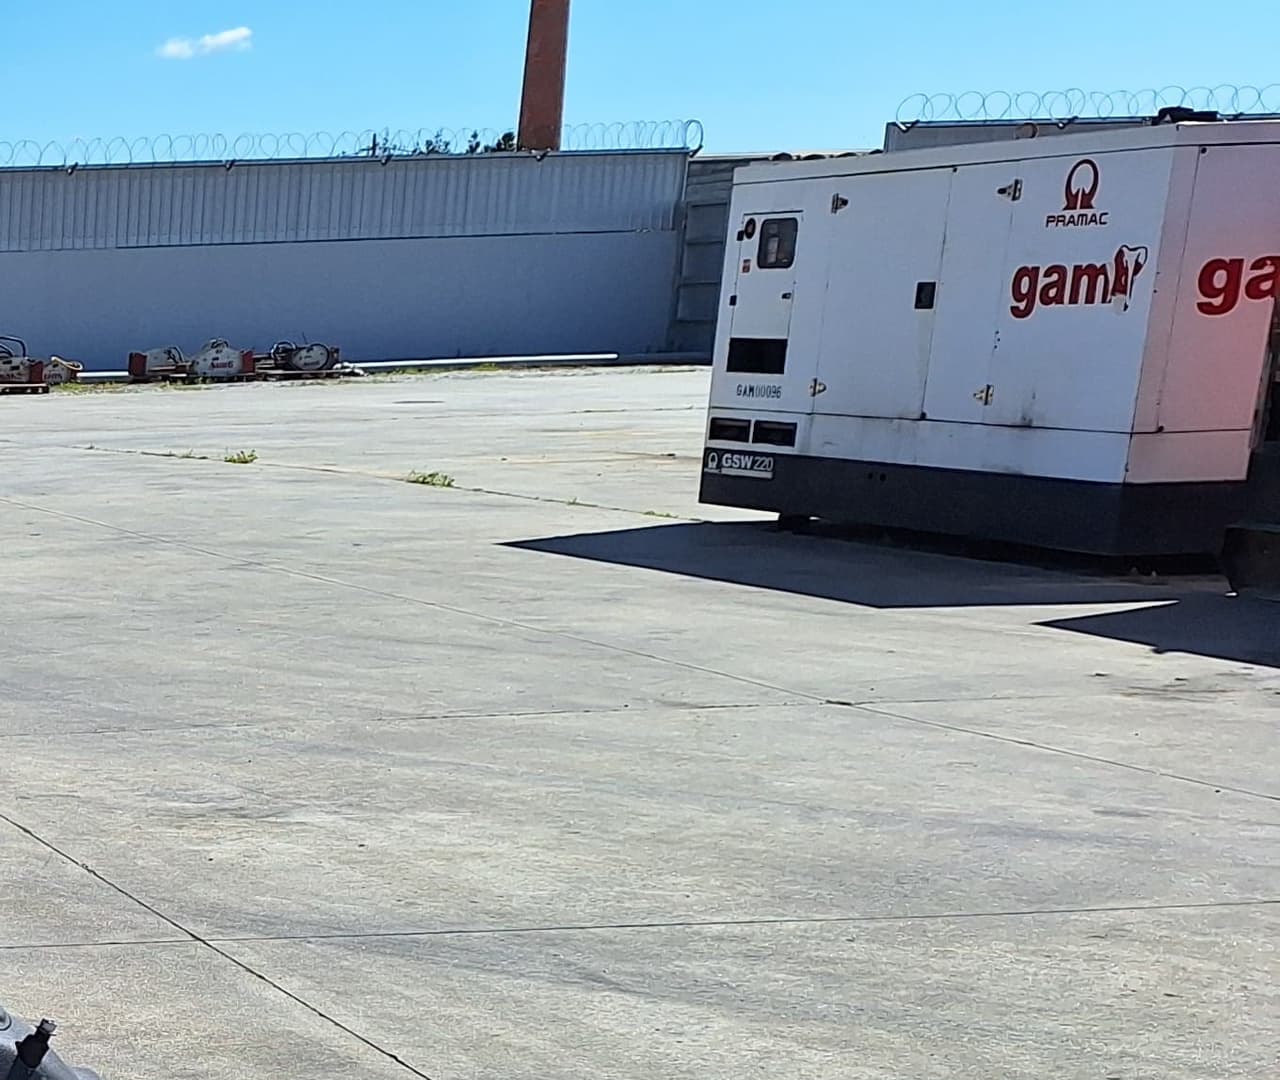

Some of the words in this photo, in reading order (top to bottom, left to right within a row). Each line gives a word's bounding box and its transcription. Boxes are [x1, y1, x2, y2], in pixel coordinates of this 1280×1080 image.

[1045, 212, 1109, 228] PRAMAC
[1196, 255, 1280, 315] ga
[736, 384, 782, 399] GAM00096
[721, 453, 753, 470] GSW
[753, 456, 774, 471] 220
